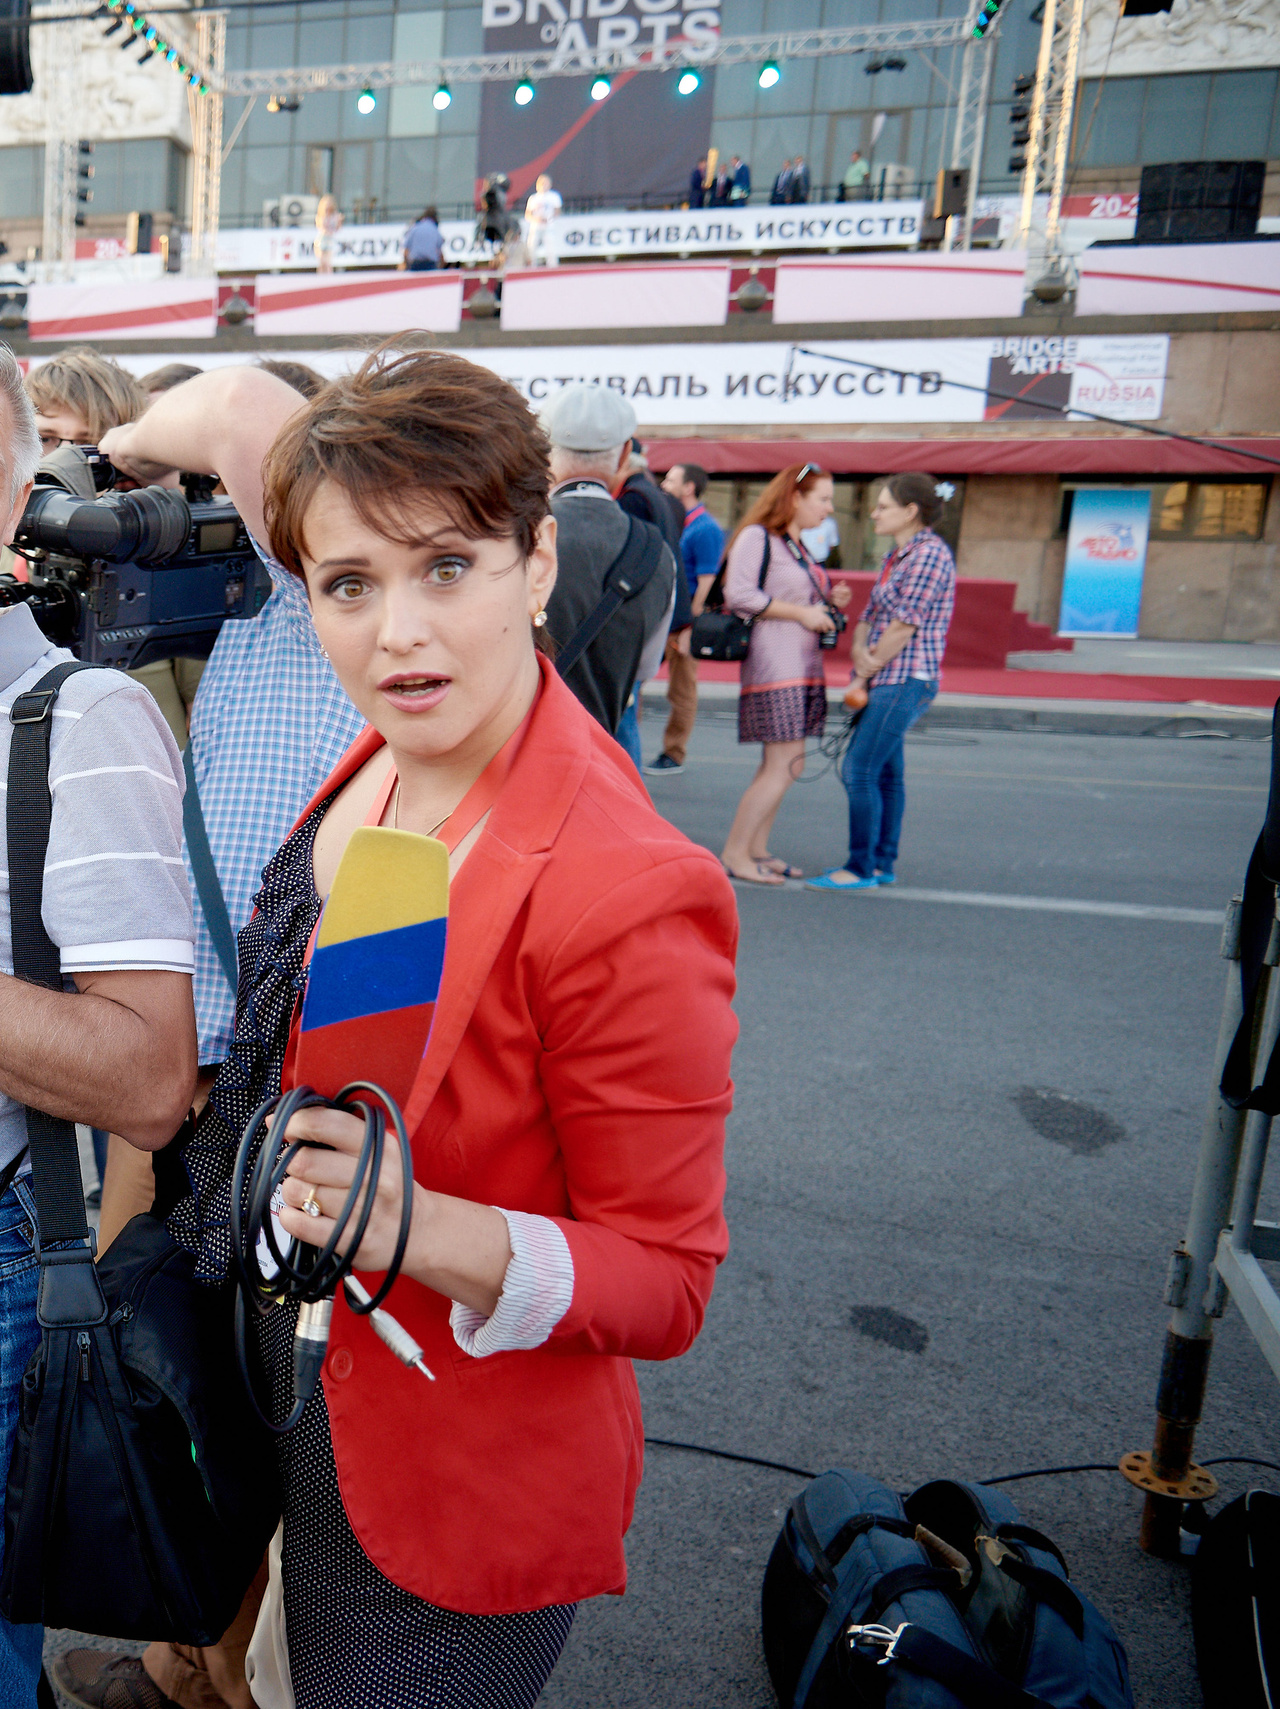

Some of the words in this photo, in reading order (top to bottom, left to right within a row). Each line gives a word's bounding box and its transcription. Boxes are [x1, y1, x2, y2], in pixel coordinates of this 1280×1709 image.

[546, 9, 720, 73] ARTS
[565, 221, 743, 247] ФЕСТИВАЛЬ
[755, 216, 917, 240] ИСКУССТВ
[989, 336, 1079, 358] BRIDGE
[1010, 355, 1075, 375] ARTS
[725, 371, 943, 397] ИСКУССТВ
[1077, 386, 1157, 402] RUSSIA
